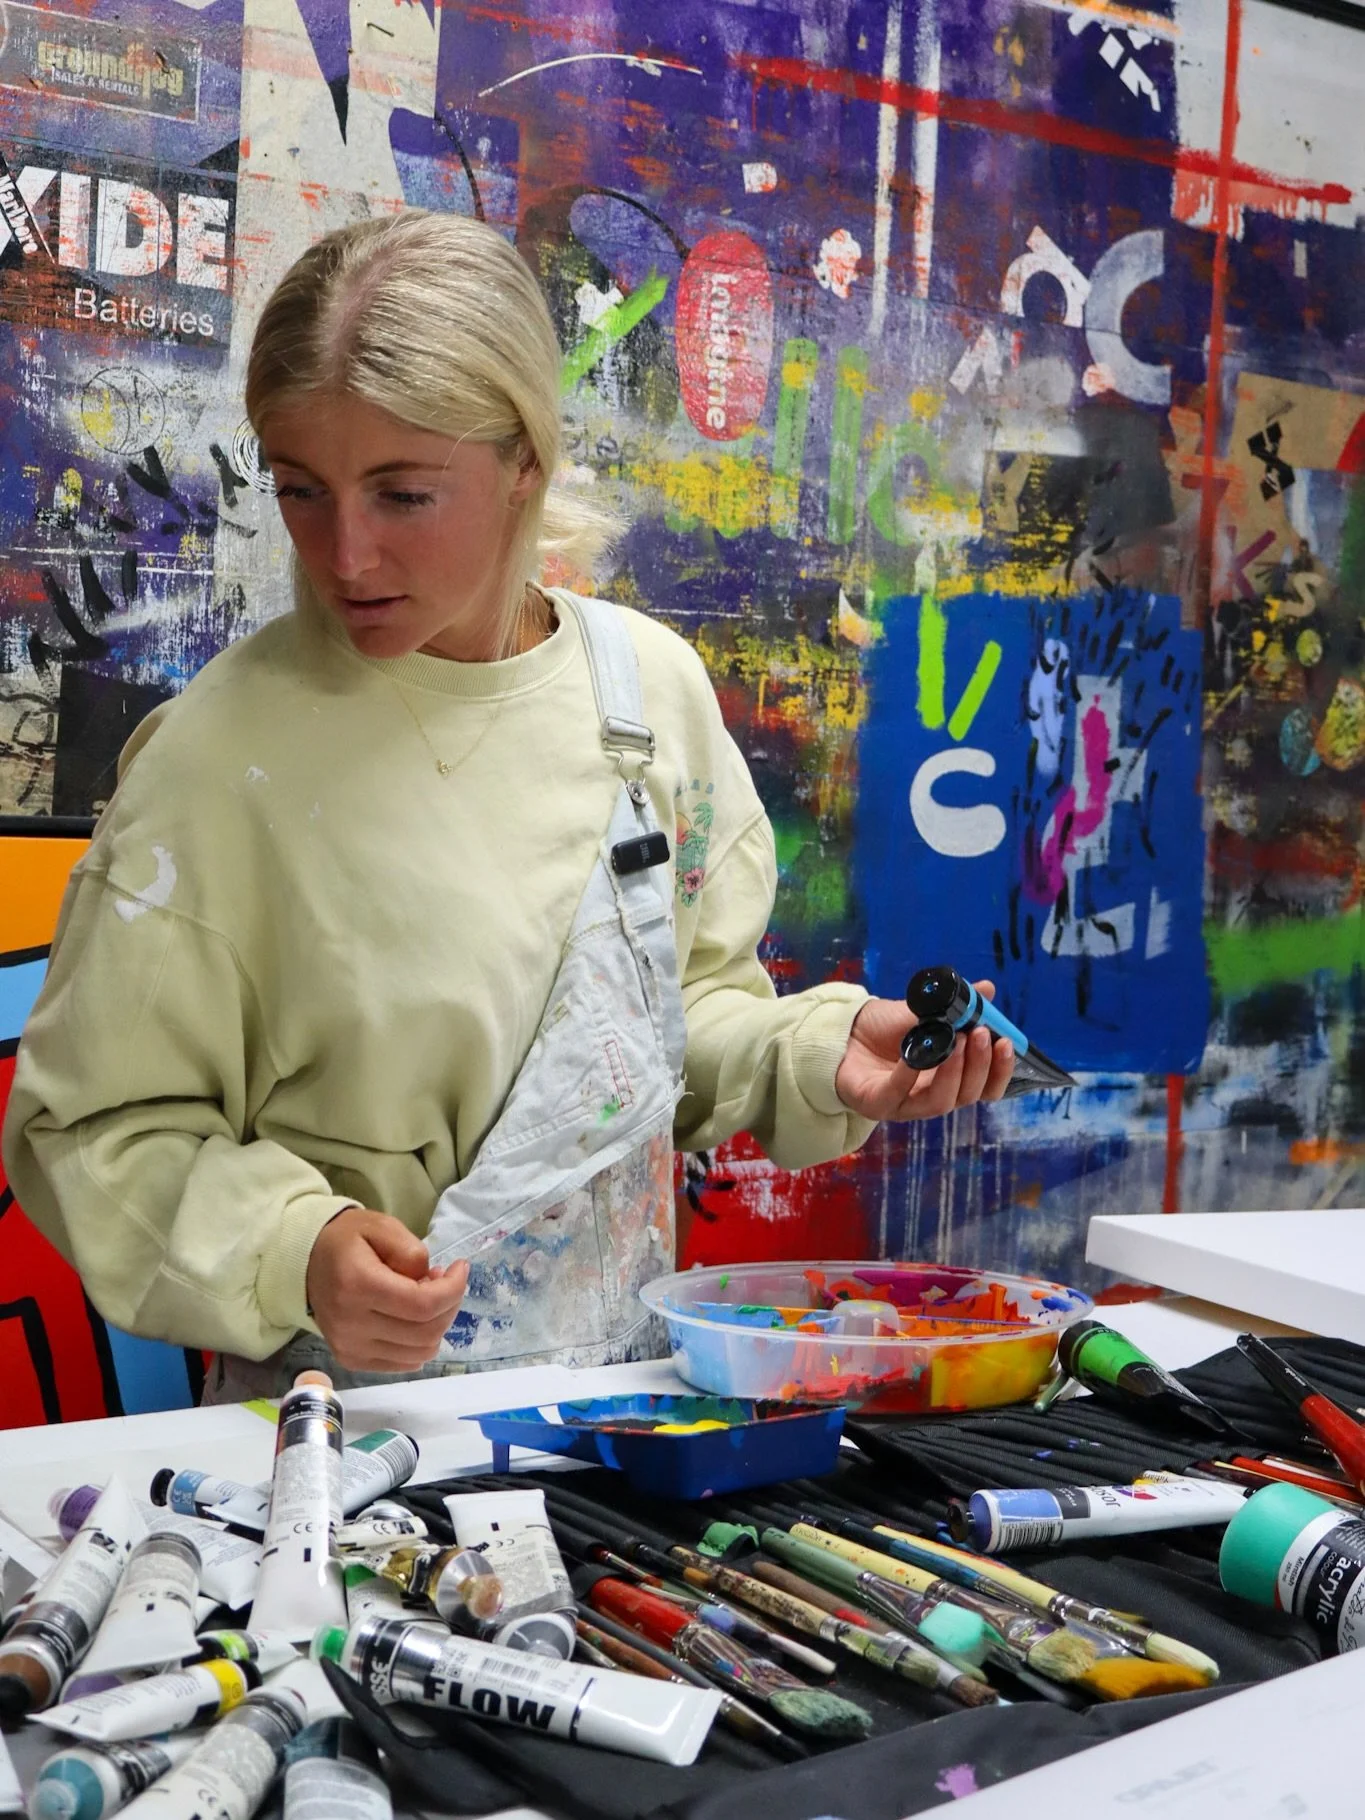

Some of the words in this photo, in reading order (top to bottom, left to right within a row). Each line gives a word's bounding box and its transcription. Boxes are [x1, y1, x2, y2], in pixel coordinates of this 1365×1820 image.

[55, 71, 85, 87] SALES
[87, 77, 96, 88] &
[98, 78, 141, 96] RENTALS
[0, 173, 38, 255] Marlboro
[74, 287, 214, 337] Batteries
[1287, 1556, 1304, 1587] Mintish
[1319, 1551, 1338, 1577] colour
[1316, 1556, 1351, 1624] acrylic
[423, 1675, 556, 1730] FLOW
